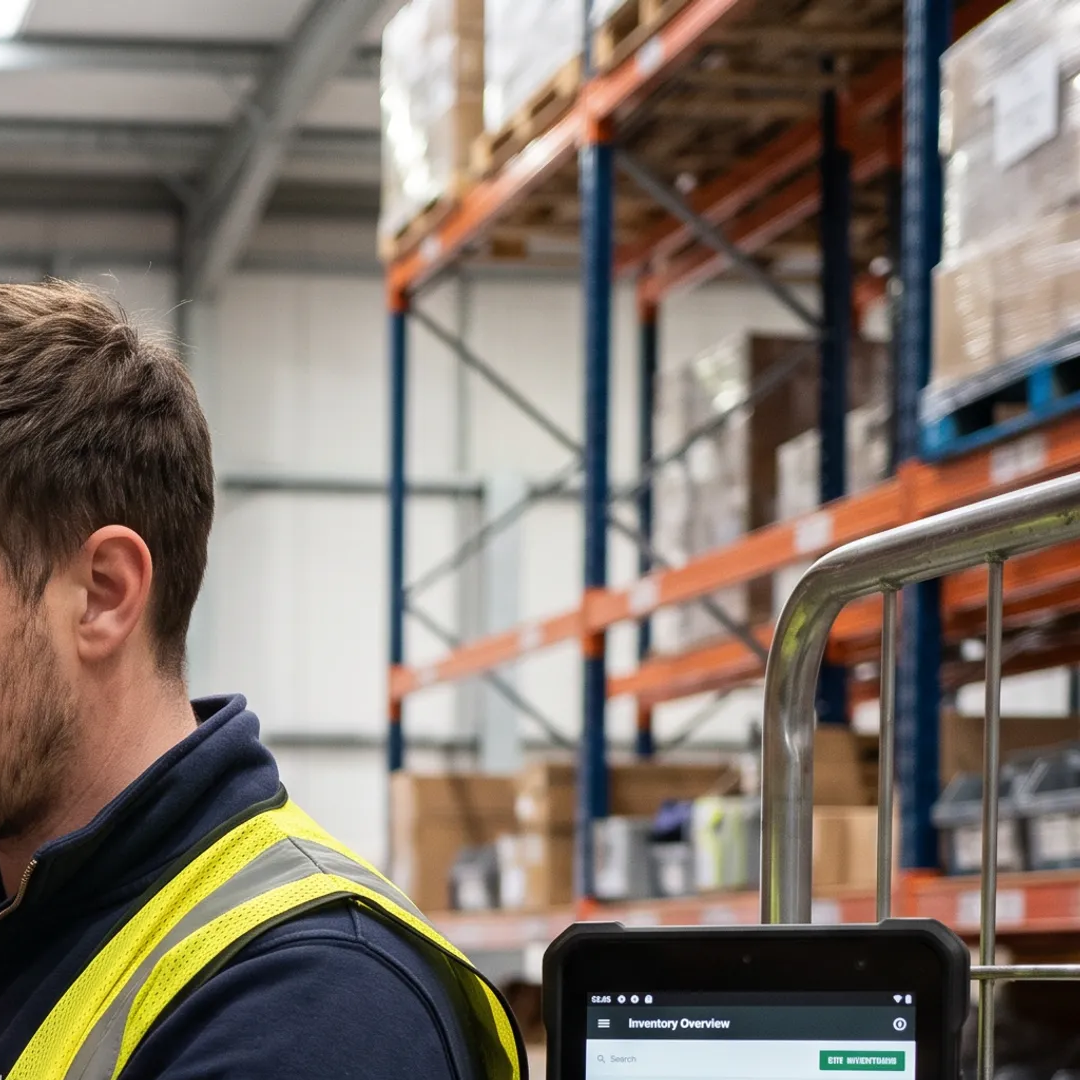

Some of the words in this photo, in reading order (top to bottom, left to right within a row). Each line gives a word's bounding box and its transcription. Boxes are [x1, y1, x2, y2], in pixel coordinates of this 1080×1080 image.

[628, 1017, 678, 1031] Inventory
[680, 1017, 730, 1029] Overview
[610, 1054, 637, 1064] Search
